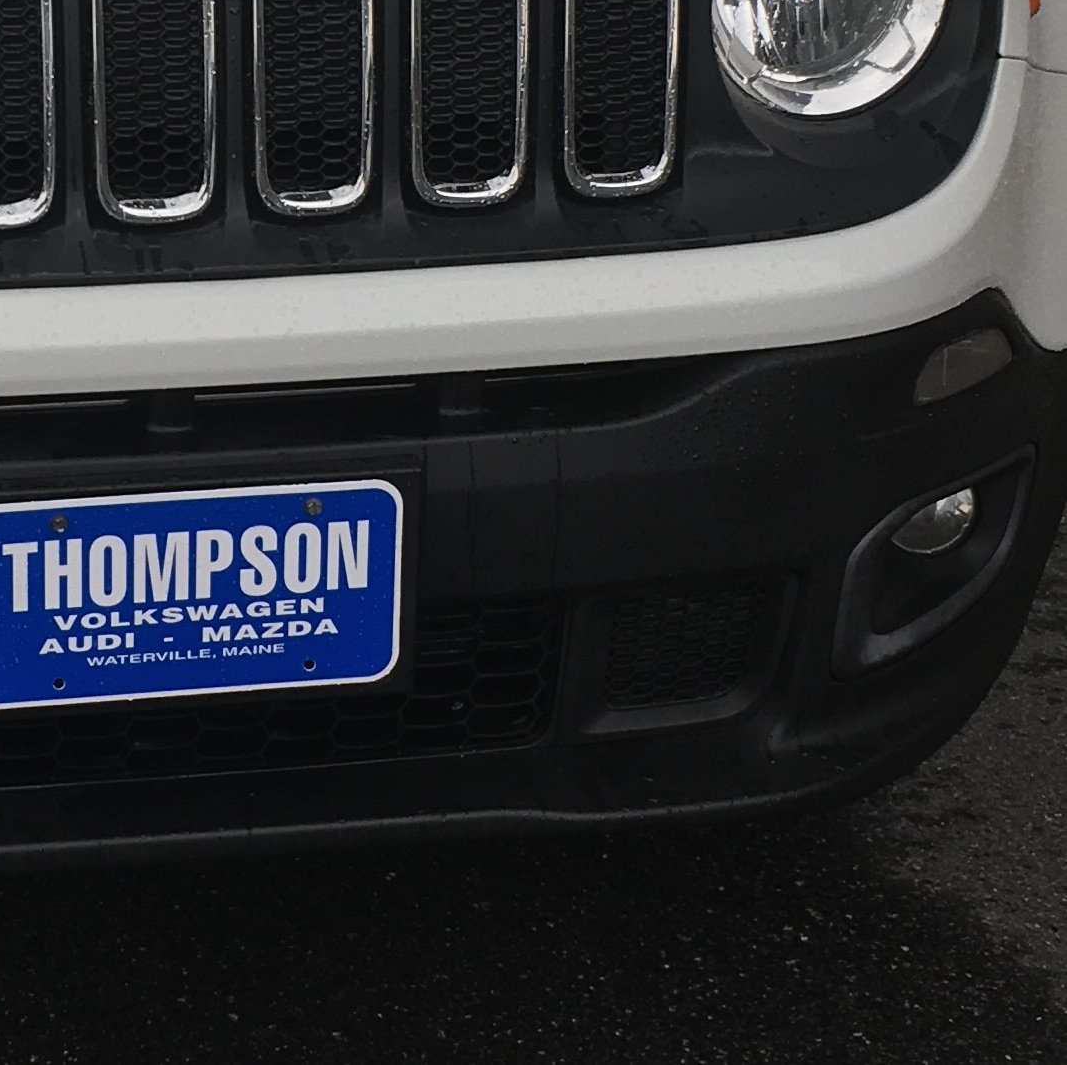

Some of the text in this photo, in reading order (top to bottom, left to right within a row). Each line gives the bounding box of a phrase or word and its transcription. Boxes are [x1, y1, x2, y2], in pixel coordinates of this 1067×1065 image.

[2, 519, 370, 613] THOMPSON
[53, 597, 325, 631] VOLKSWAGEN
[39, 632, 135, 655] AUDI
[201, 618, 339, 643] MAZDA
[86, 643, 285, 667] WATERVILLE, MAINE
